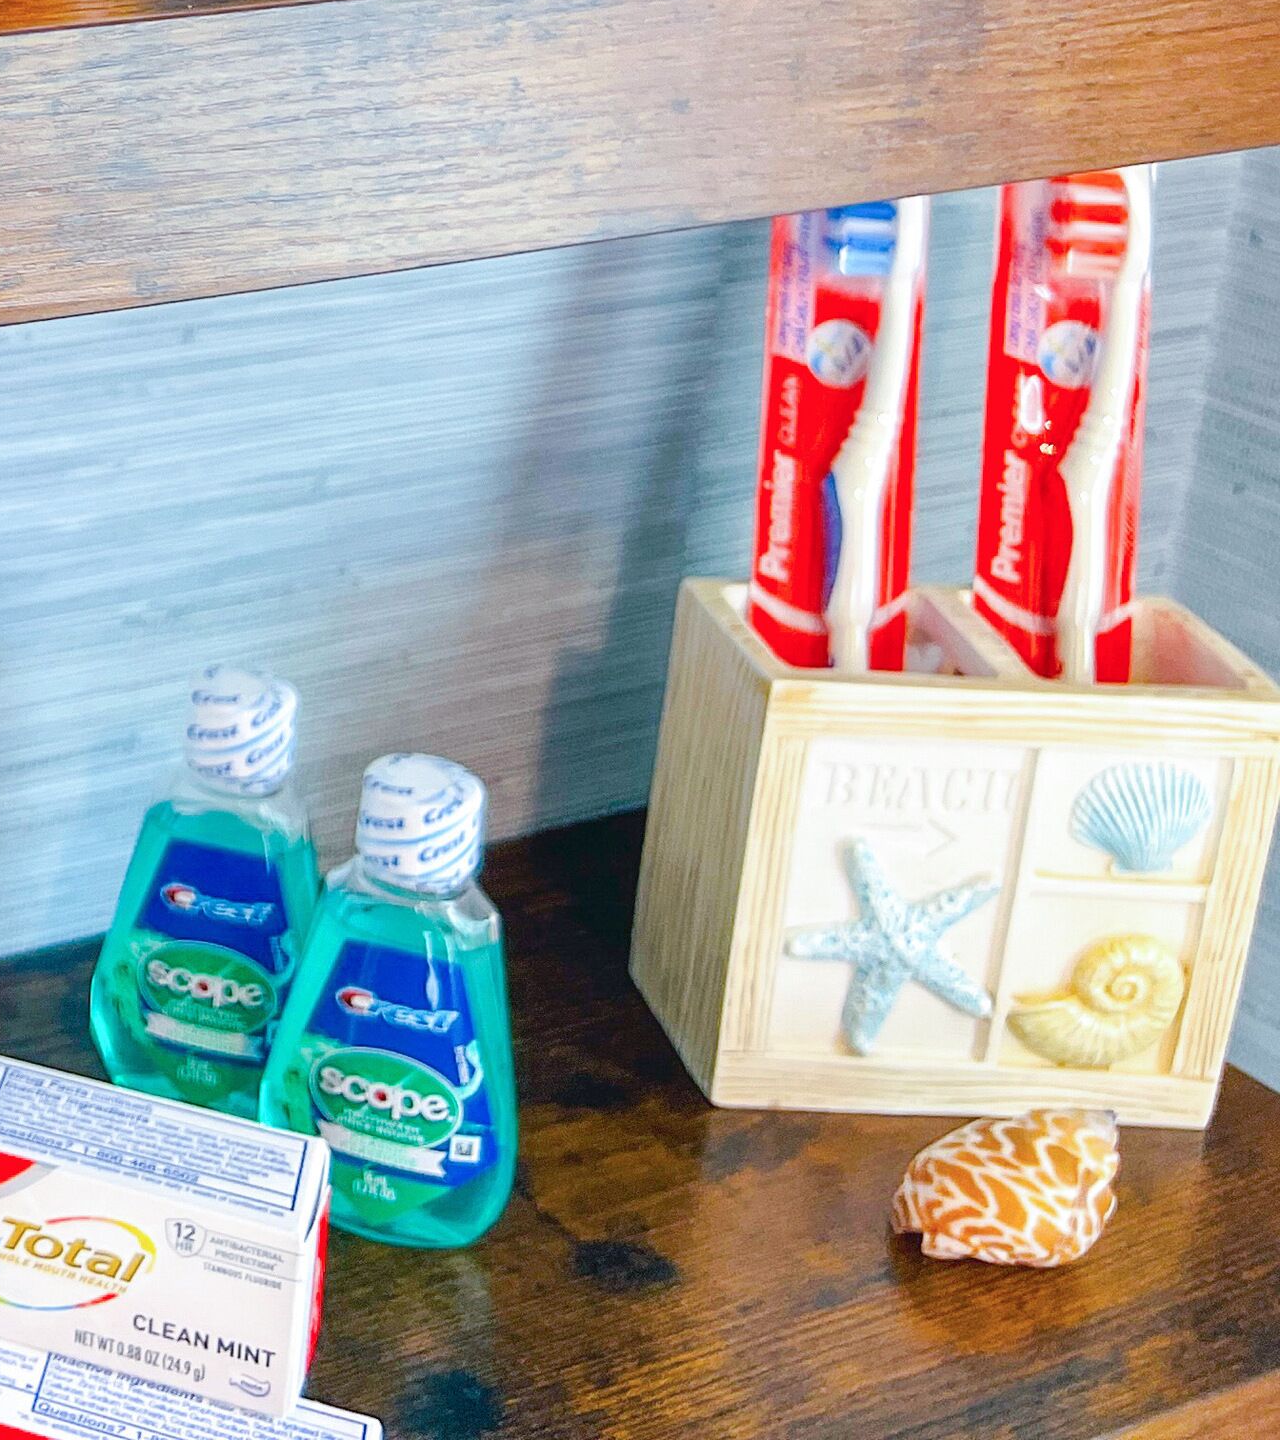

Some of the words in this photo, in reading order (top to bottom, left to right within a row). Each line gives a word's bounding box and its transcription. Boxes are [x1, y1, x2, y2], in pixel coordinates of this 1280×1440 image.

[759, 449, 797, 582] Premier
[990, 449, 1028, 584] Premier
[147, 959, 264, 1009] scope
[319, 1065, 453, 1123] scope
[2, 1216, 146, 1283] Total
[173, 1222, 196, 1242] 12
[74, 1329, 96, 1348] NET
[97, 1336, 115, 1354] WT
[116, 1342, 141, 1361] 0.88
[144, 1350, 160, 1367] OZ
[162, 1353, 191, 1375] (24.9
[193, 1363, 206, 1383] g)
[133, 1314, 210, 1350] CLEAN
[217, 1337, 276, 1368] MINT
[39, 1401, 126, 1434] Questions?
